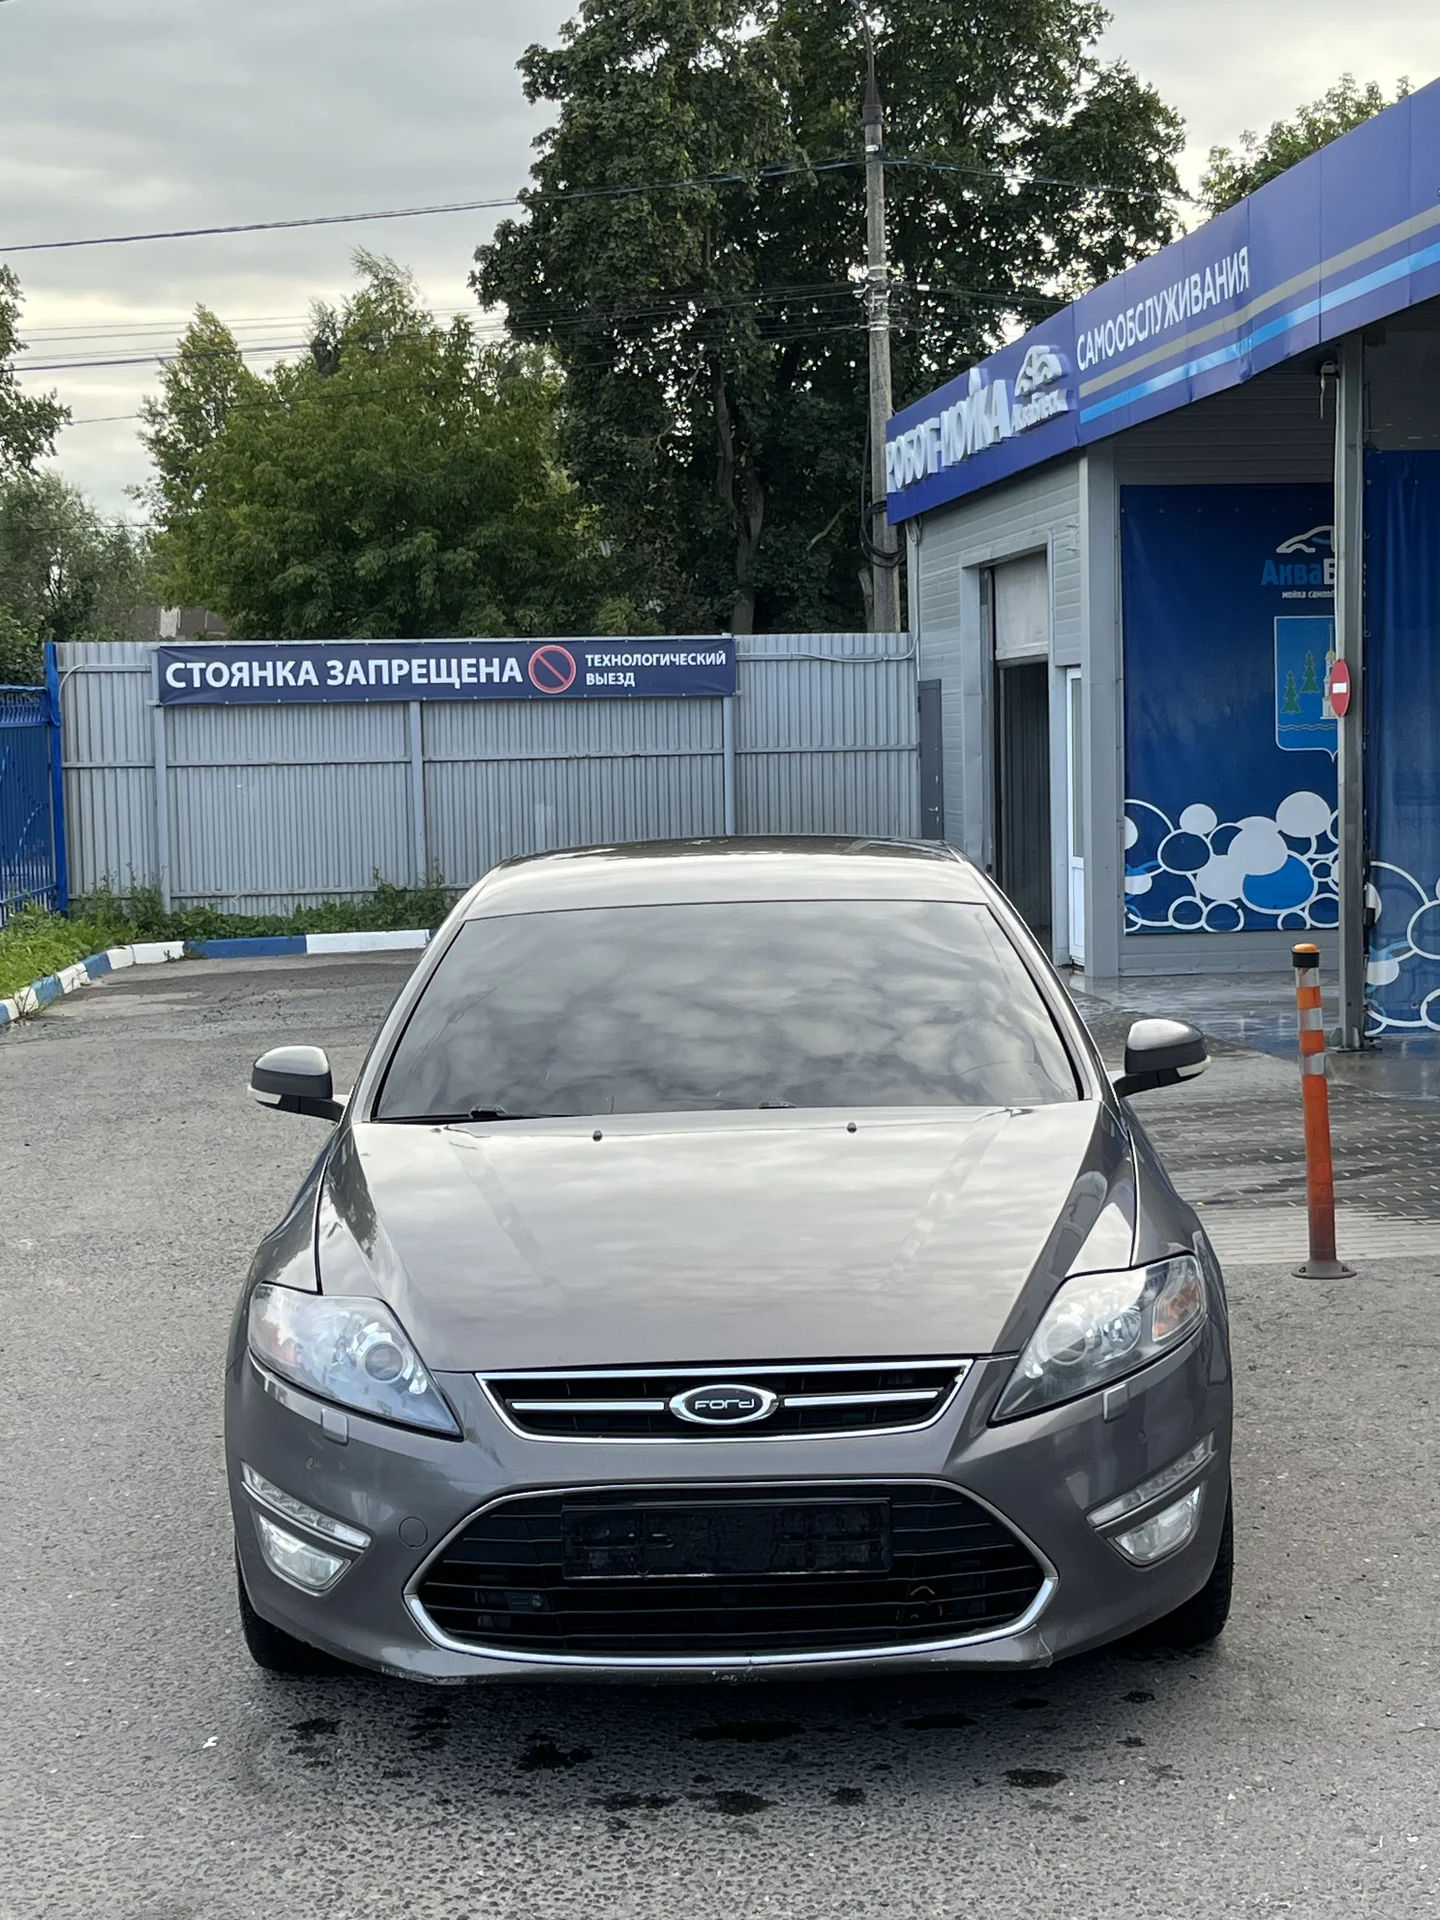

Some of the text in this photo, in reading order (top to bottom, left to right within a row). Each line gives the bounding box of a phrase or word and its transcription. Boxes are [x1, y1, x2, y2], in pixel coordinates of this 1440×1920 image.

[1077, 246, 1250, 371] САМООБСЛУЖИВАНИЯ
[1260, 558, 1336, 586] АкваБ
[585, 650, 727, 667] ТЕХНОЛОГИЧЕСКИЙ
[165, 657, 523, 689] СТОЯНКА ЗАПРЕЩЕНА
[586, 672, 636, 687] ВЫЕЗД
